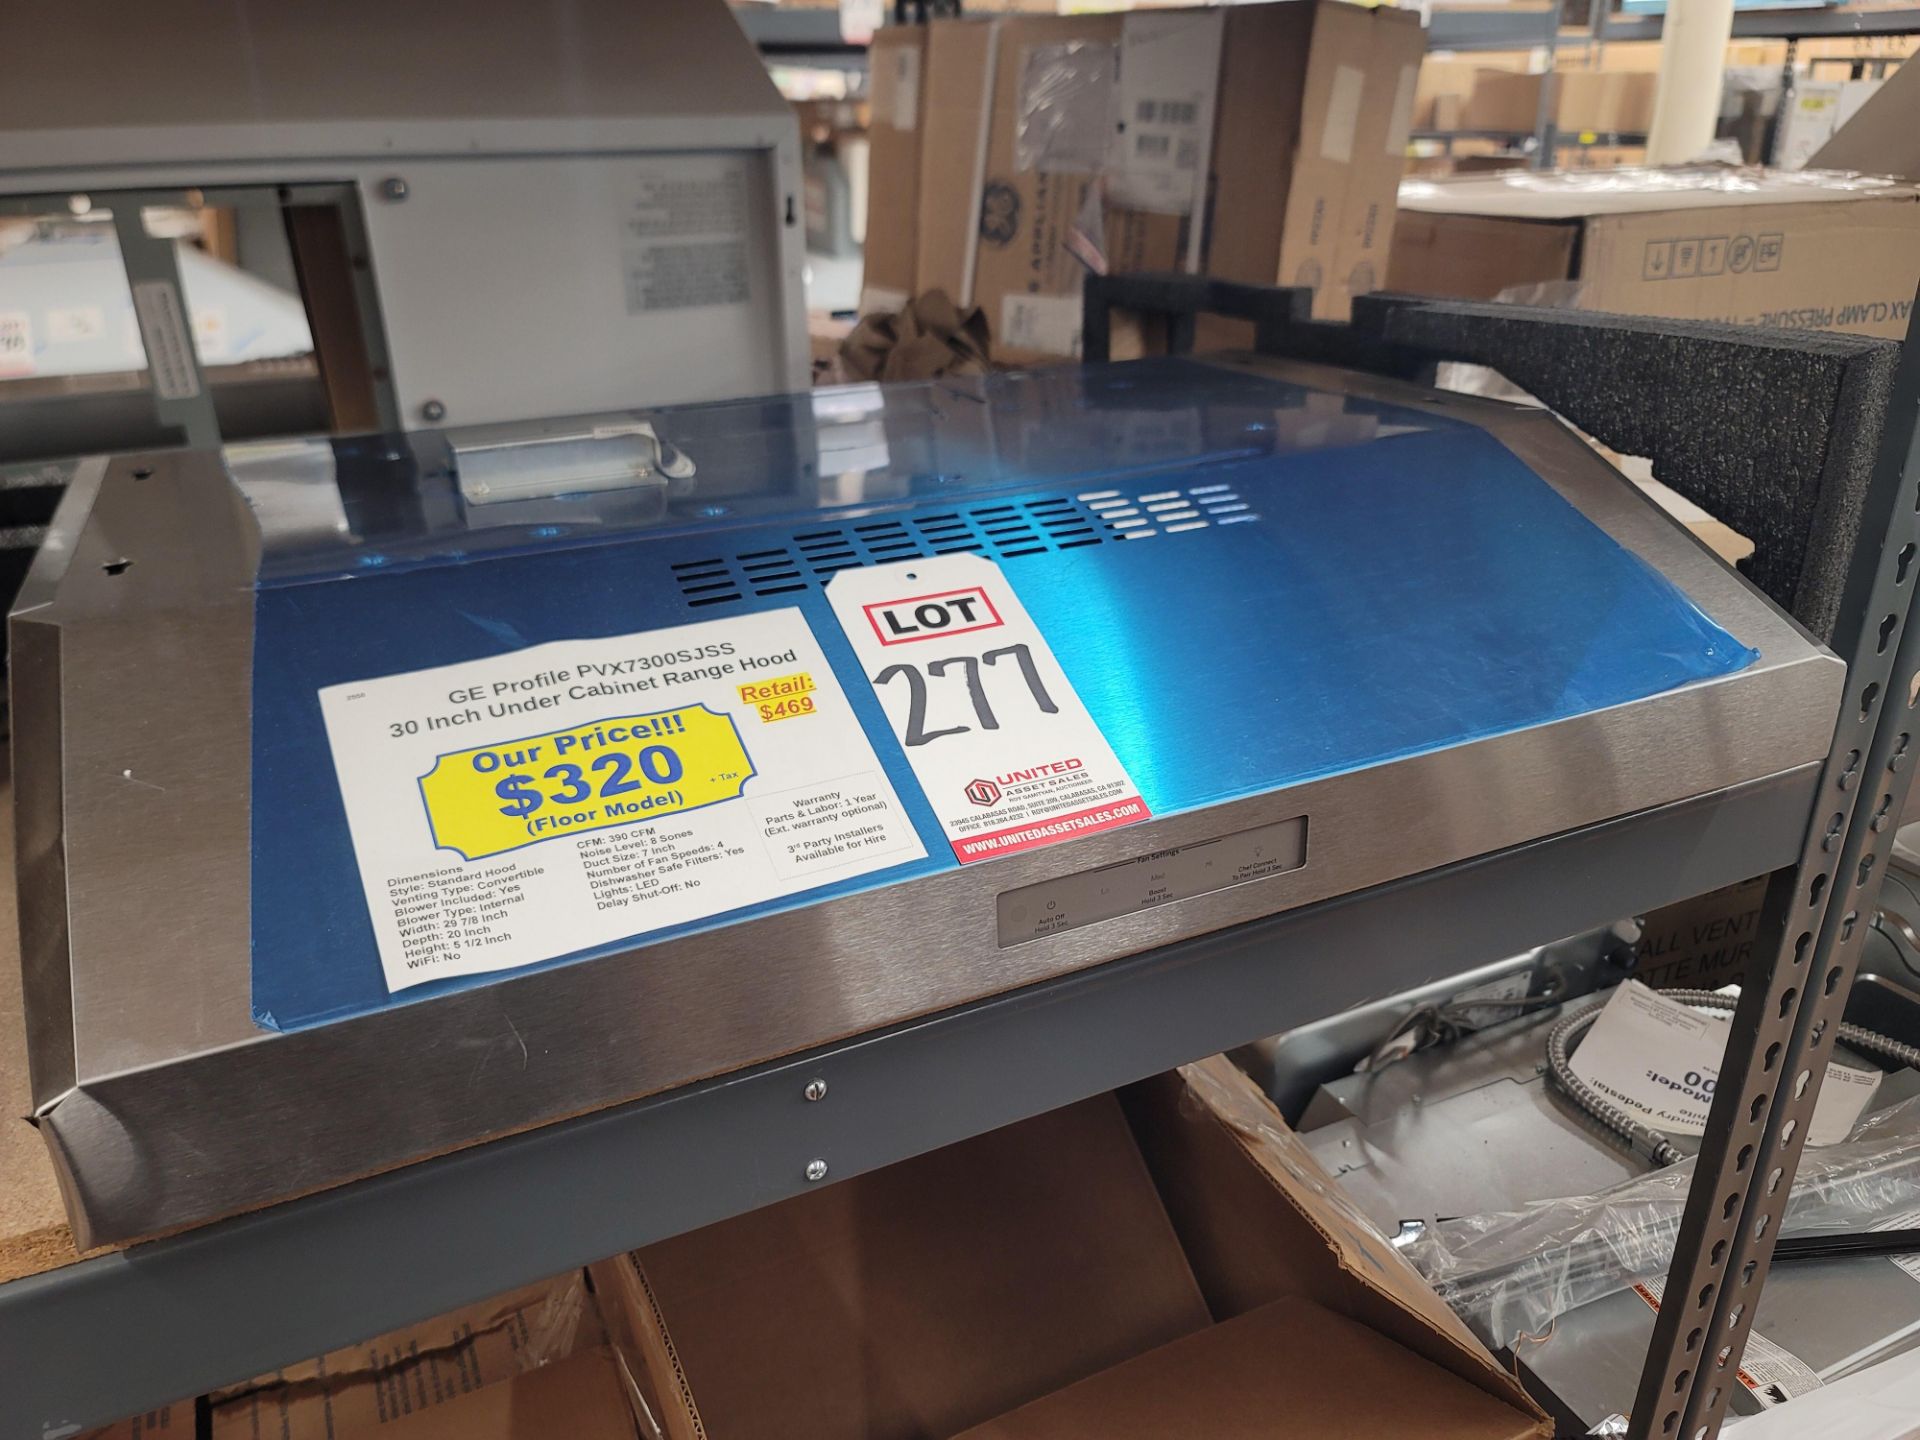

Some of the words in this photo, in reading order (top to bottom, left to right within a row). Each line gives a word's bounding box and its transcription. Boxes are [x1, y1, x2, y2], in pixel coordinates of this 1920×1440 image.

[1837, 302, 1888, 326] CLAMP
[882, 597, 976, 635] LOT
[448, 685, 487, 704] GE
[492, 669, 571, 696] Profile
[576, 642, 736, 678] PVX7300SJSS
[389, 719, 419, 738] 30
[427, 708, 482, 731] Inch
[488, 693, 562, 718] Under
[568, 676, 659, 701] Cabinet
[662, 663, 735, 686] Range
[739, 649, 798, 671] Hood
[740, 675, 814, 702] Retail:
[872, 643, 1059, 747] 277
[759, 696, 814, 721] $469
[472, 745, 542, 773] Our
[553, 714, 686, 756] Price!!!
[494, 745, 684, 820] $320
[719, 770, 739, 782] Tax
[996, 757, 1083, 785] UNITED
[1006, 782, 1046, 797] ASSET
[1049, 772, 1089, 786] SALES
[526, 809, 597, 837] (Floor
[604, 789, 684, 818] Model)
[765, 813, 796, 826] Parts
[797, 811, 807, 819] &
[807, 801, 843, 816] Labor:
[845, 798, 852, 807] 1
[852, 792, 877, 805] Year
[792, 791, 841, 809] Warranty
[764, 825, 791, 839] (Ext.
[792, 813, 839, 832] warranty
[841, 800, 888, 819] optional)
[958, 822, 982, 833] OFFICE
[962, 803, 1141, 855] WWW.UNITEDASSETSALES.COM
[970, 807, 1008, 823] CALABASAS
[576, 837, 606, 850] CFM:
[608, 832, 628, 844] 390
[630, 827, 656, 839] CFM
[580, 848, 612, 860] Noise
[614, 839, 648, 852] Level:
[650, 837, 657, 845] 8
[659, 829, 694, 843] Sones
[795, 846, 846, 864] Available
[846, 840, 862, 850] for
[864, 834, 887, 846] Hire
[803, 836, 833, 850] Party
[834, 824, 885, 843] Installers
[583, 858, 610, 870] Duct
[612, 852, 640, 864] Size:
[642, 849, 648, 857] 7
[651, 844, 676, 856] Inch
[586, 864, 631, 880] Number
[634, 860, 646, 869] of
[648, 856, 669, 867] Fan
[670, 844, 714, 861] Speeds:
[716, 840, 724, 849] 4
[590, 870, 656, 890] Dishwasher
[658, 863, 683, 875] Safe
[685, 853, 723, 868] Filters:
[724, 846, 745, 858] Yes
[387, 865, 464, 888] Dimensions
[390, 883, 425, 898] Style:
[427, 872, 482, 889] Standard
[485, 863, 517, 878] Hood
[392, 891, 439, 907] Venting
[442, 884, 475, 900] Type:
[477, 866, 545, 890] Convertible
[593, 885, 633, 901] Lights:
[635, 878, 660, 892] LED
[394, 902, 437, 918] Blower
[440, 890, 497, 907] Included:
[499, 883, 521, 896] Yes
[596, 896, 629, 912] Delay
[632, 883, 683, 903] Shut-Off:
[684, 879, 701, 890] No
[1149, 886, 1167, 897] Boost
[397, 911, 440, 928] Blower
[443, 906, 477, 919] Type:
[479, 893, 525, 912] Internal
[399, 922, 440, 938] Width:
[443, 919, 458, 929] 29
[460, 915, 479, 927] 7/8
[482, 909, 509, 923] Inch
[1038, 915, 1053, 925] Auto
[1054, 912, 1066, 921] Off
[402, 932, 443, 949] Depth:
[447, 929, 461, 939] 20
[464, 925, 491, 937] Inch
[1034, 923, 1050, 933] Hold
[405, 941, 450, 960] Height:
[453, 940, 461, 949] 5
[464, 938, 482, 948] 1/2
[485, 932, 512, 945] Inch
[406, 955, 440, 970] WiFi:
[443, 952, 461, 962] No
[1646, 1068, 1712, 1105] Model:
